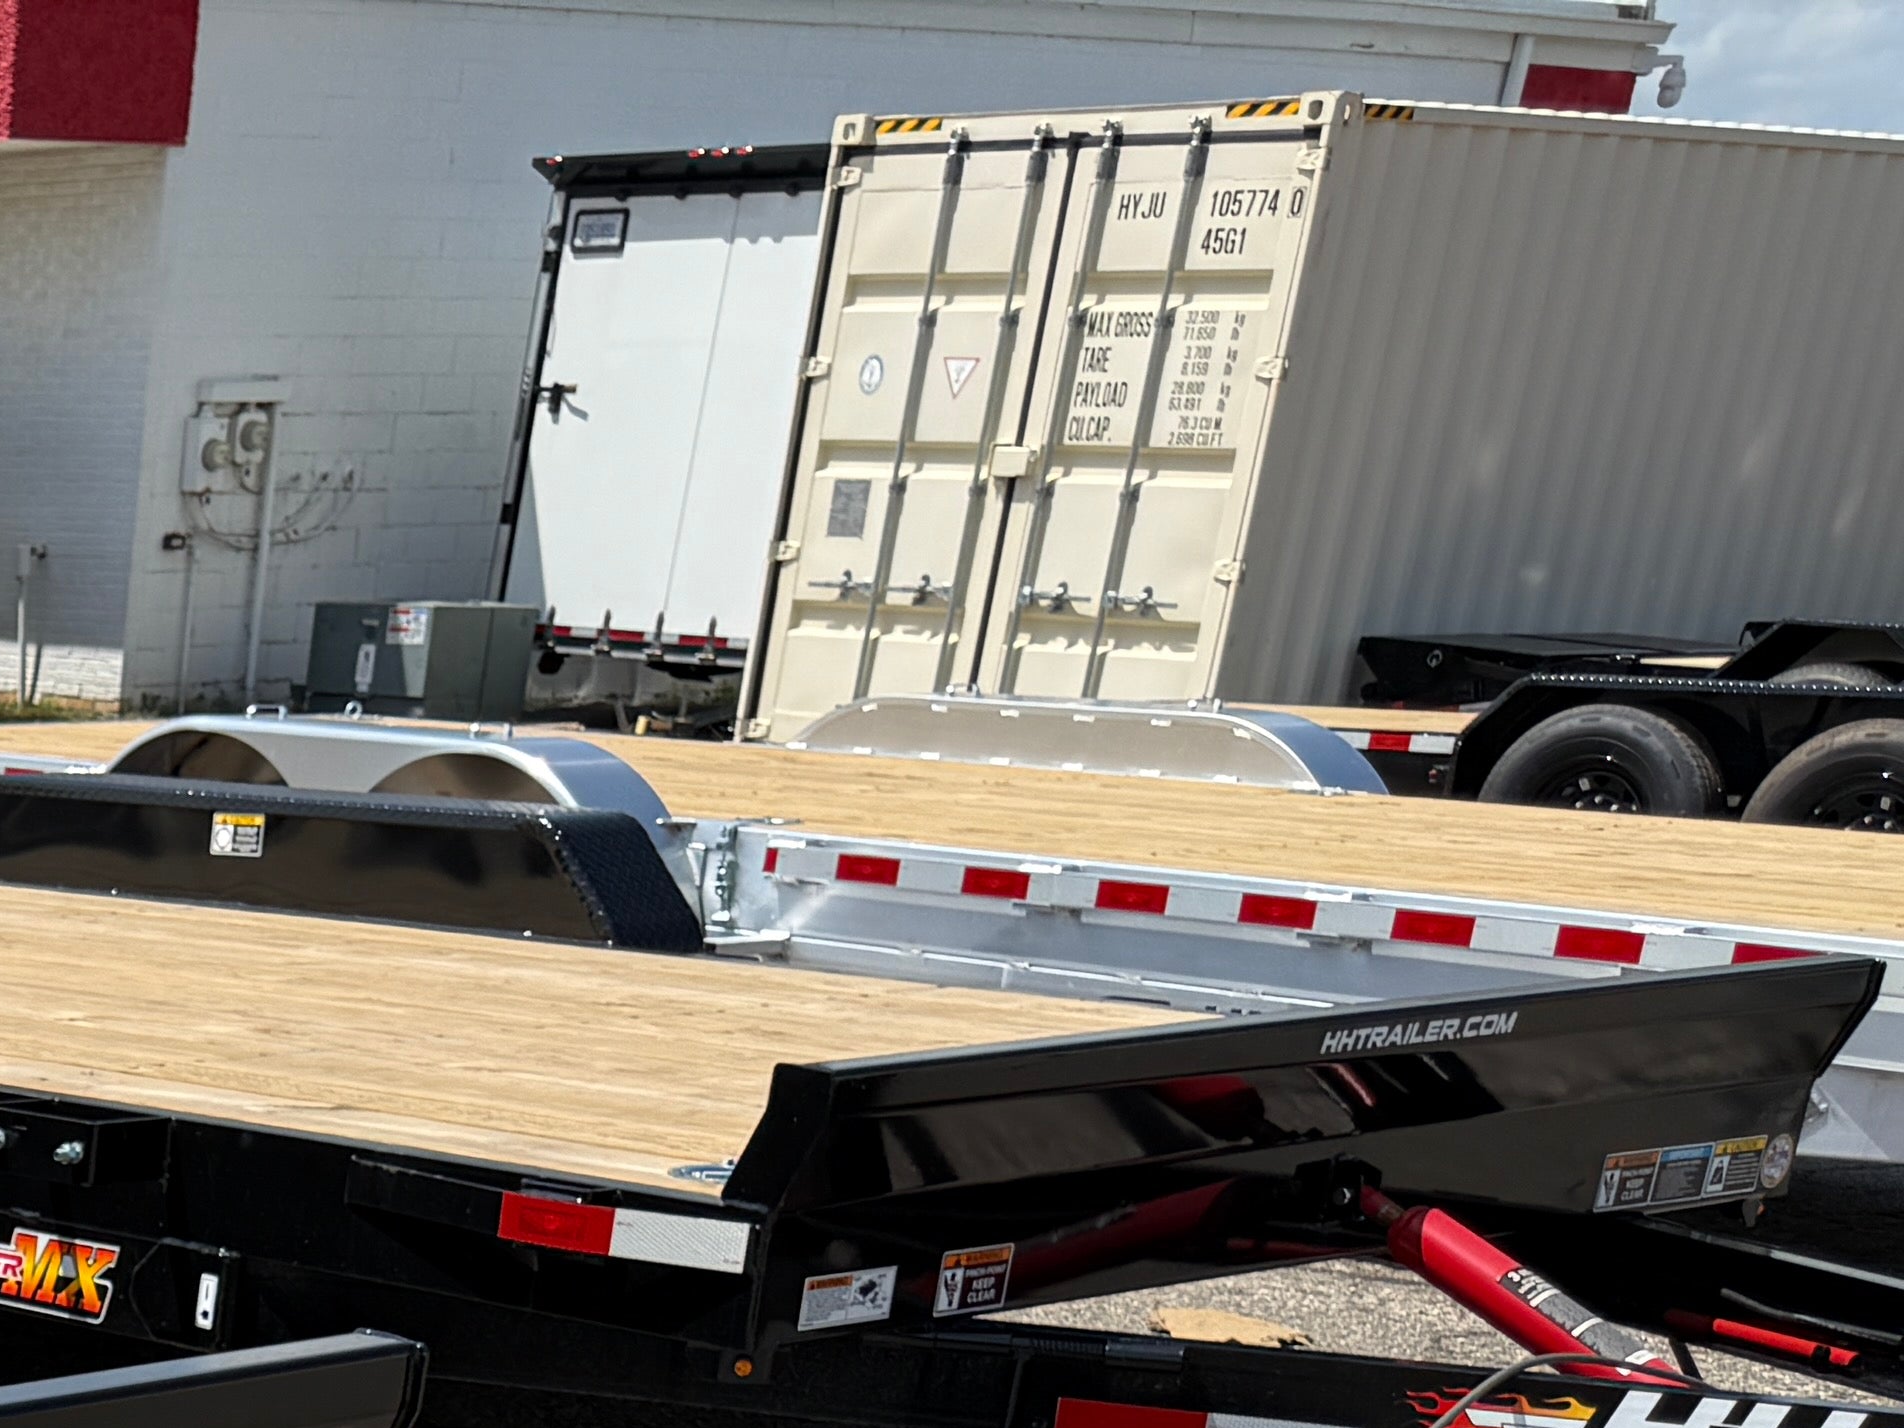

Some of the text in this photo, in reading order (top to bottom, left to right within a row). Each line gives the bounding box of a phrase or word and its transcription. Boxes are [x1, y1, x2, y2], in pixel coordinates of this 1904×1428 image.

[1117, 191, 1167, 220] HYJU
[1210, 187, 1305, 217] 105774 0
[1200, 227, 1247, 255] 45G1
[1086, 311, 1154, 338] MAX GROSS
[1234, 311, 1246, 327] kg
[1081, 346, 1112, 373] TARE
[1073, 381, 1128, 408] PAYLOAD
[1319, 1011, 1519, 1055] HHTRAILER.COM
[0, 1232, 119, 1315] MX
